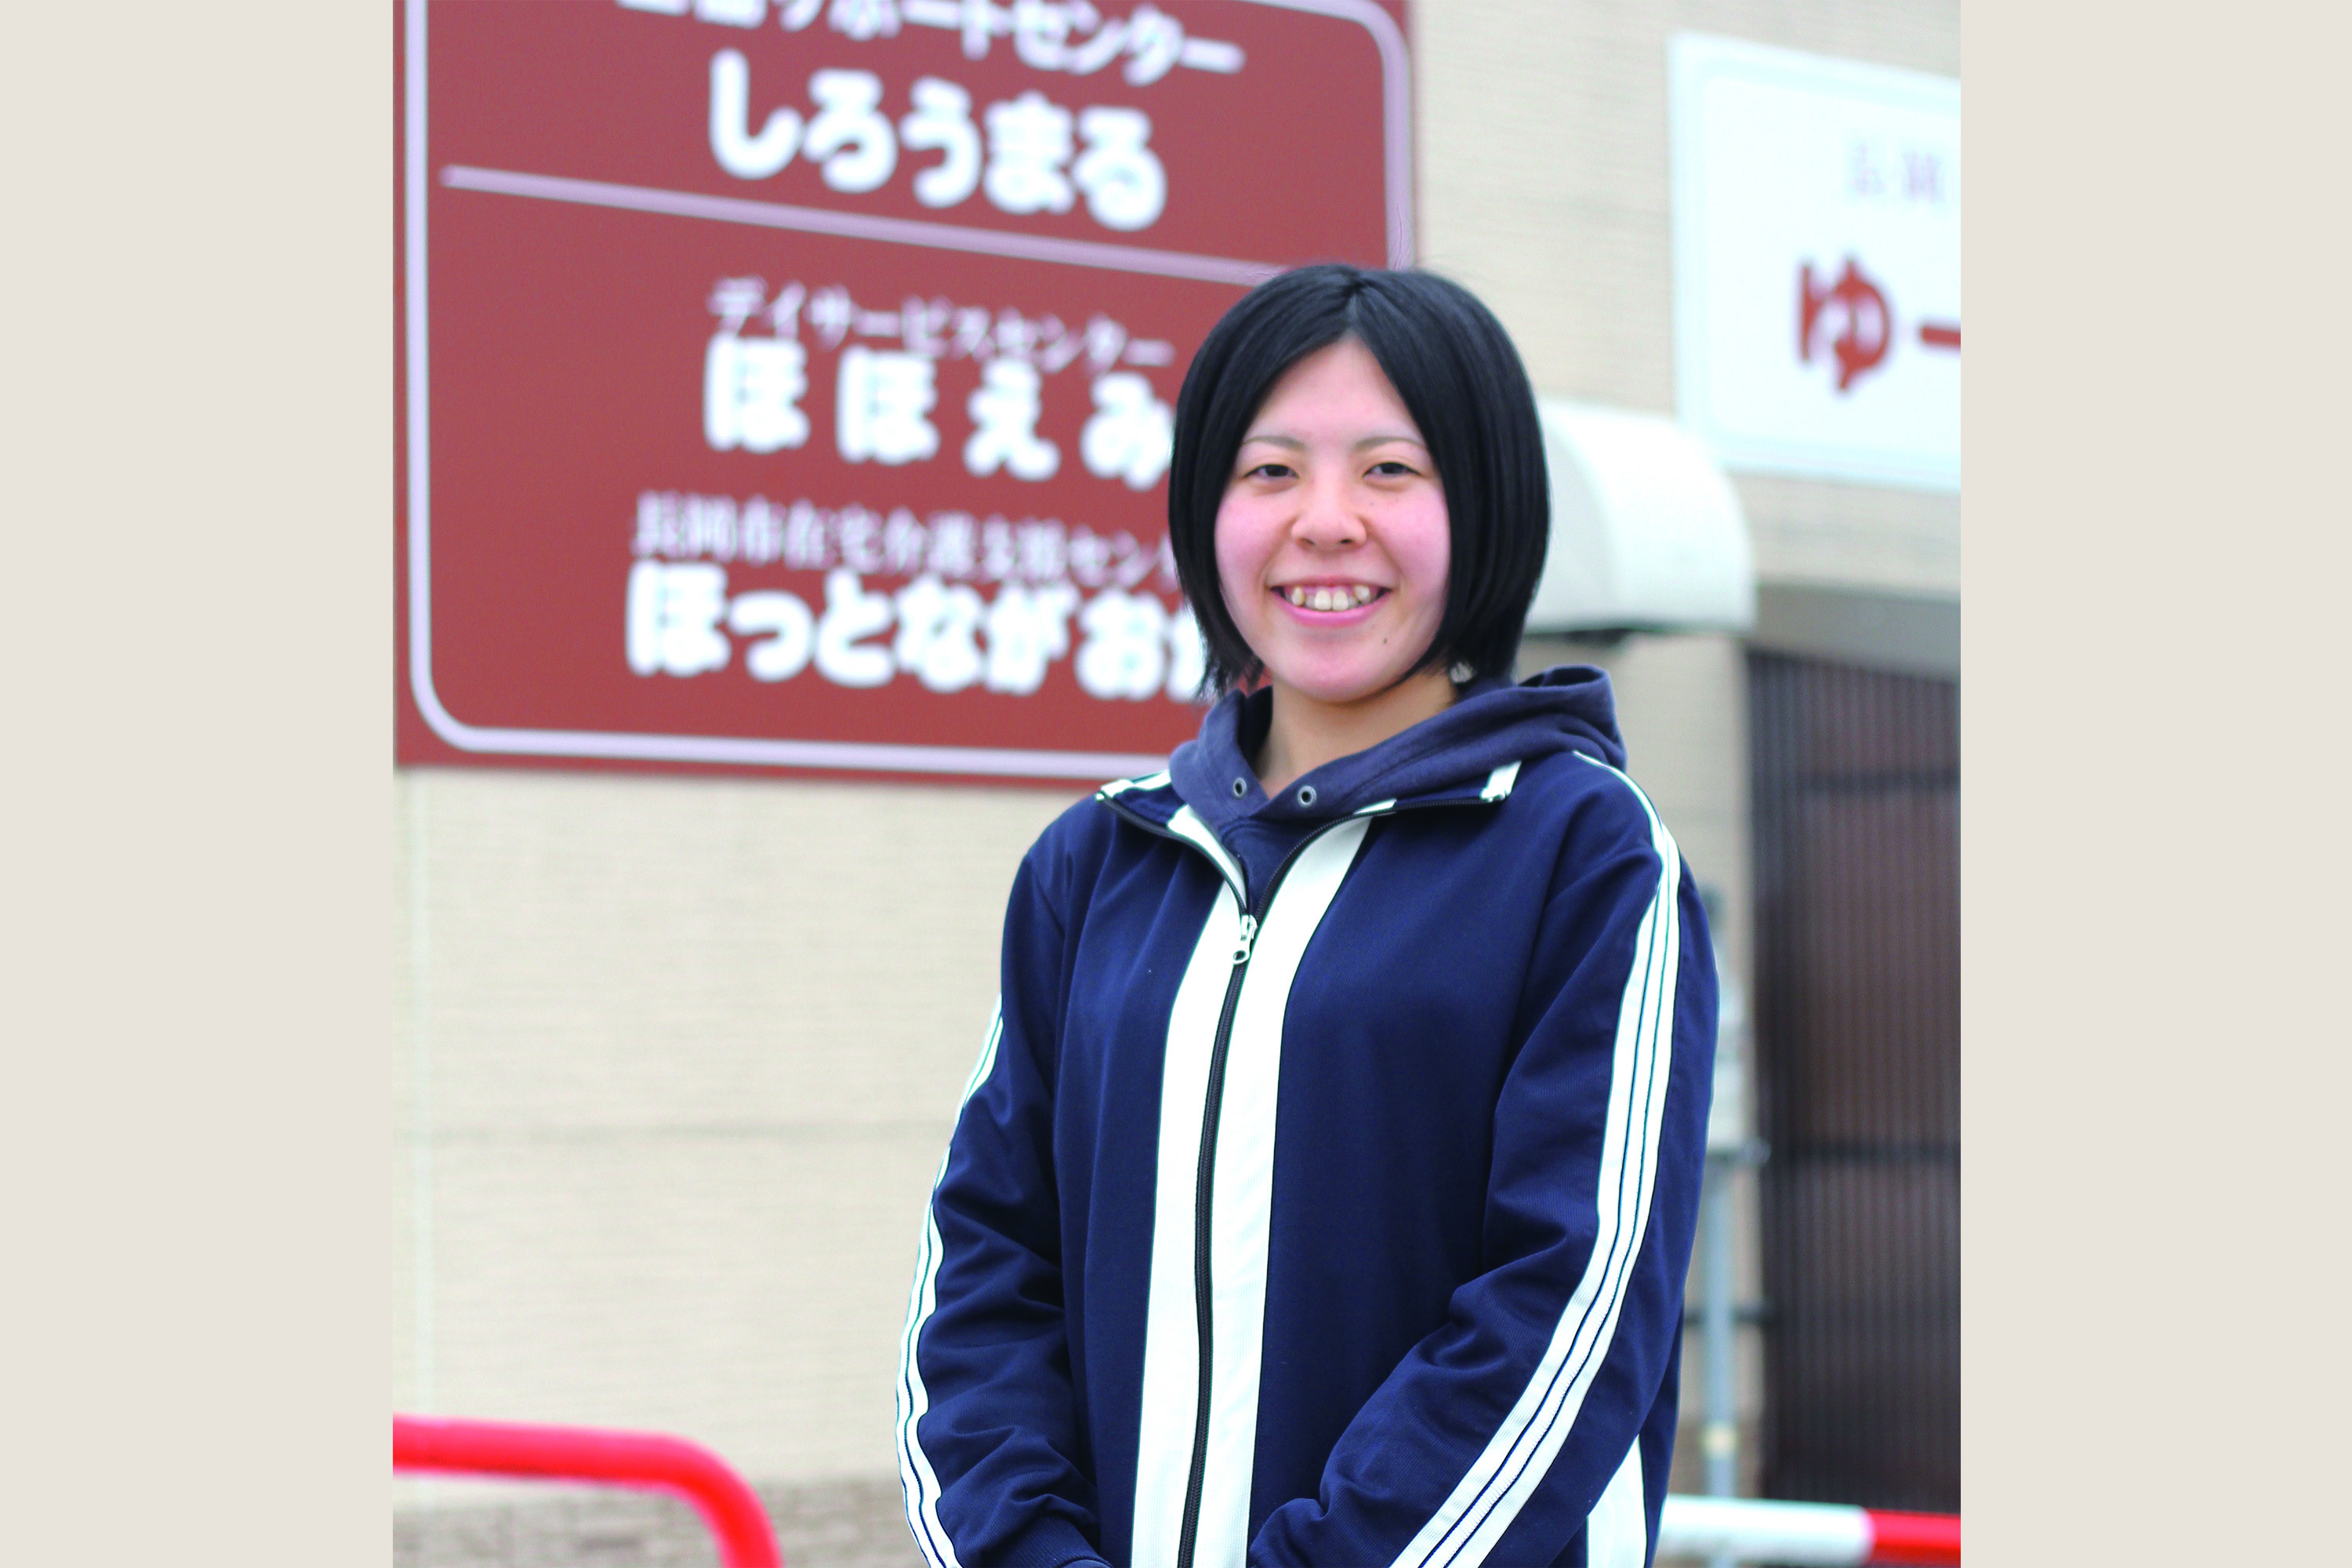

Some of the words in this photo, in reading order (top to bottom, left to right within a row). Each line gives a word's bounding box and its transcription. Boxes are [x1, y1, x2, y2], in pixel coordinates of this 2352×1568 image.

[708, 48, 1168, 231] しろうまる
[704, 332, 1174, 491] ほほえみ
